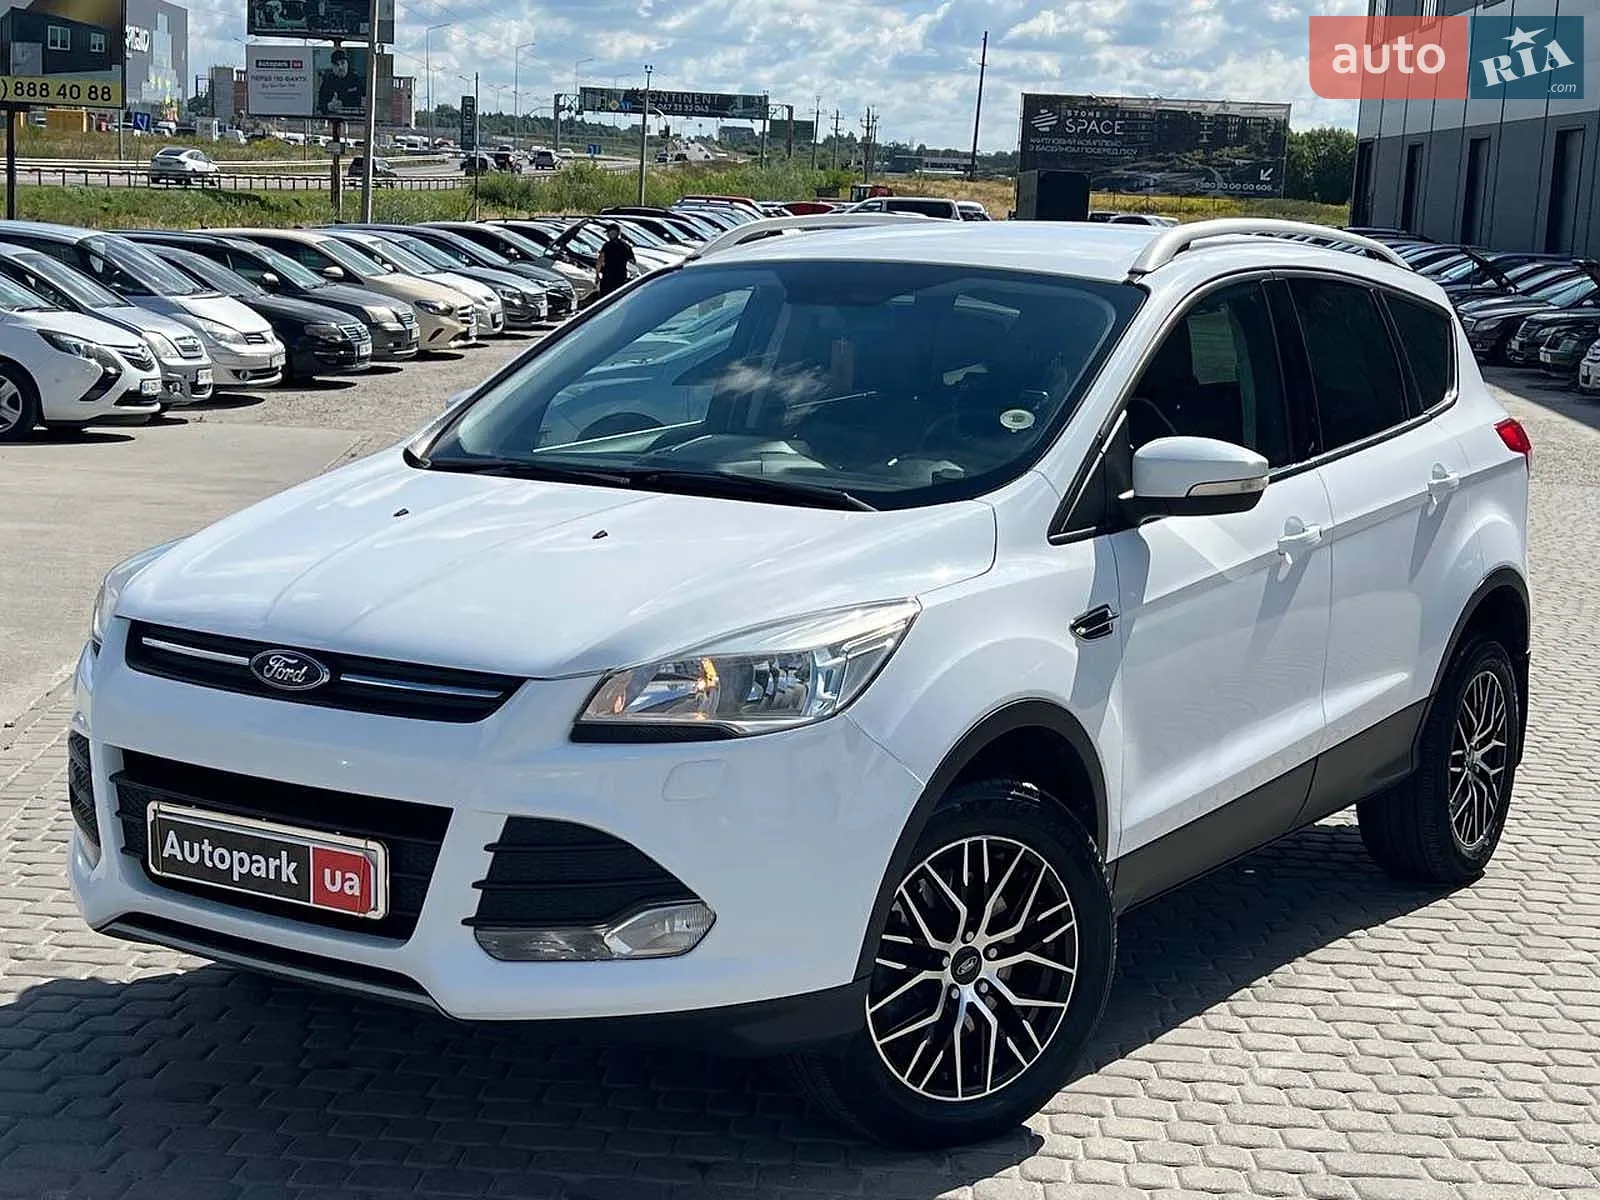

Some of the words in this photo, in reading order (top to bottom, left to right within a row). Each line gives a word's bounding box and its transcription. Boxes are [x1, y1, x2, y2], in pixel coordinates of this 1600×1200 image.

[14, 81, 50, 98] 888
[56, 83, 81, 100] 40
[87, 85, 112, 102] 88
[1065, 118, 1125, 135] SPACE
[263, 654, 308, 685] Ford
[162, 829, 299, 885] Autopark
[324, 866, 360, 897] ua
